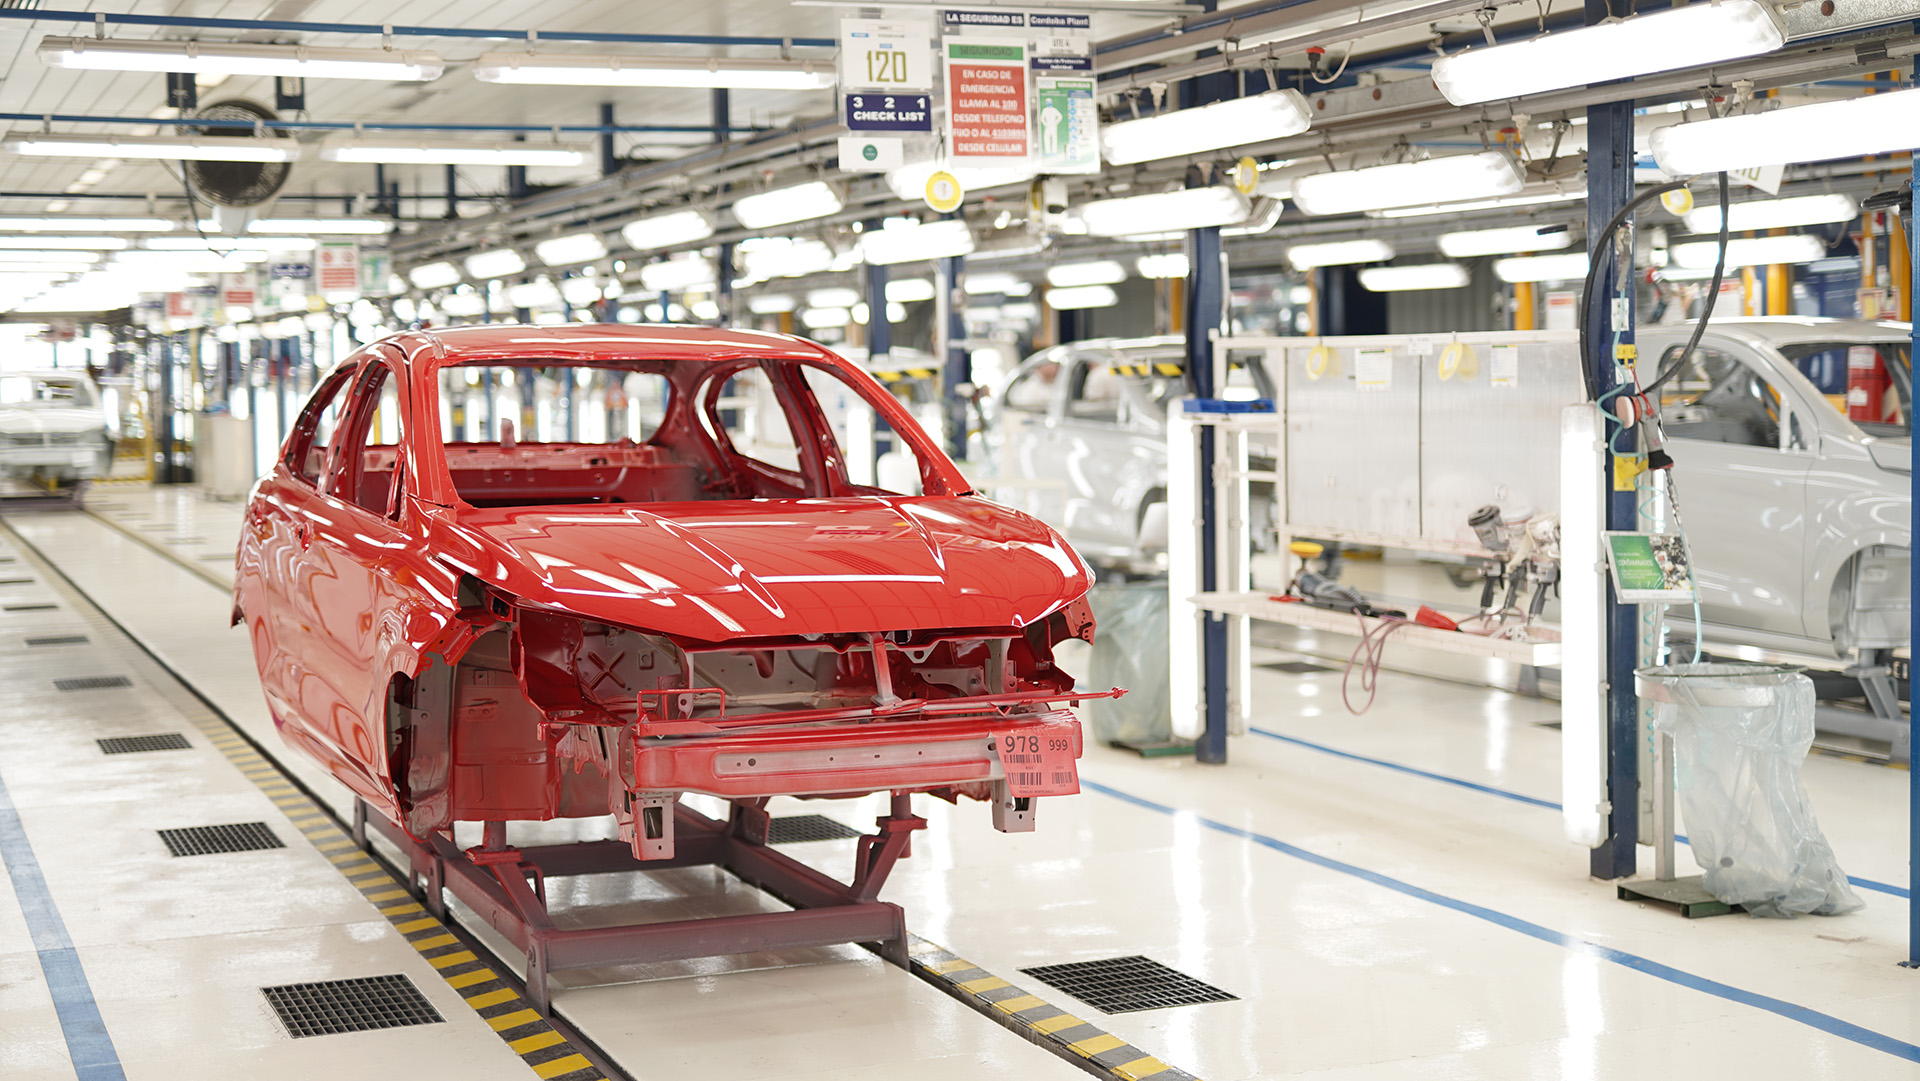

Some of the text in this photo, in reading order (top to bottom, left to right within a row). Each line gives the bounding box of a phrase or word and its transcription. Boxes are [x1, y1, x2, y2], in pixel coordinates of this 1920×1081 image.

[946, 13, 1023, 25] LA SEGURIDAD ES
[867, 50, 907, 83] 120
[962, 69, 1012, 79] EN CASO DE
[960, 84, 1016, 94] EMERGENCIA
[853, 96, 926, 109] 3 2 1
[959, 99, 989, 108] LLAMA
[990, 99, 1001, 108] AL
[853, 111, 926, 122] CHECK LIST
[954, 113, 1025, 124] DESDE TELEFONO
[971, 128, 979, 138] O
[980, 128, 991, 138] AL
[958, 143, 1023, 152] DESDE CELULAR
[1005, 735, 1039, 753] 978
[1048, 739, 1068, 751] 999
